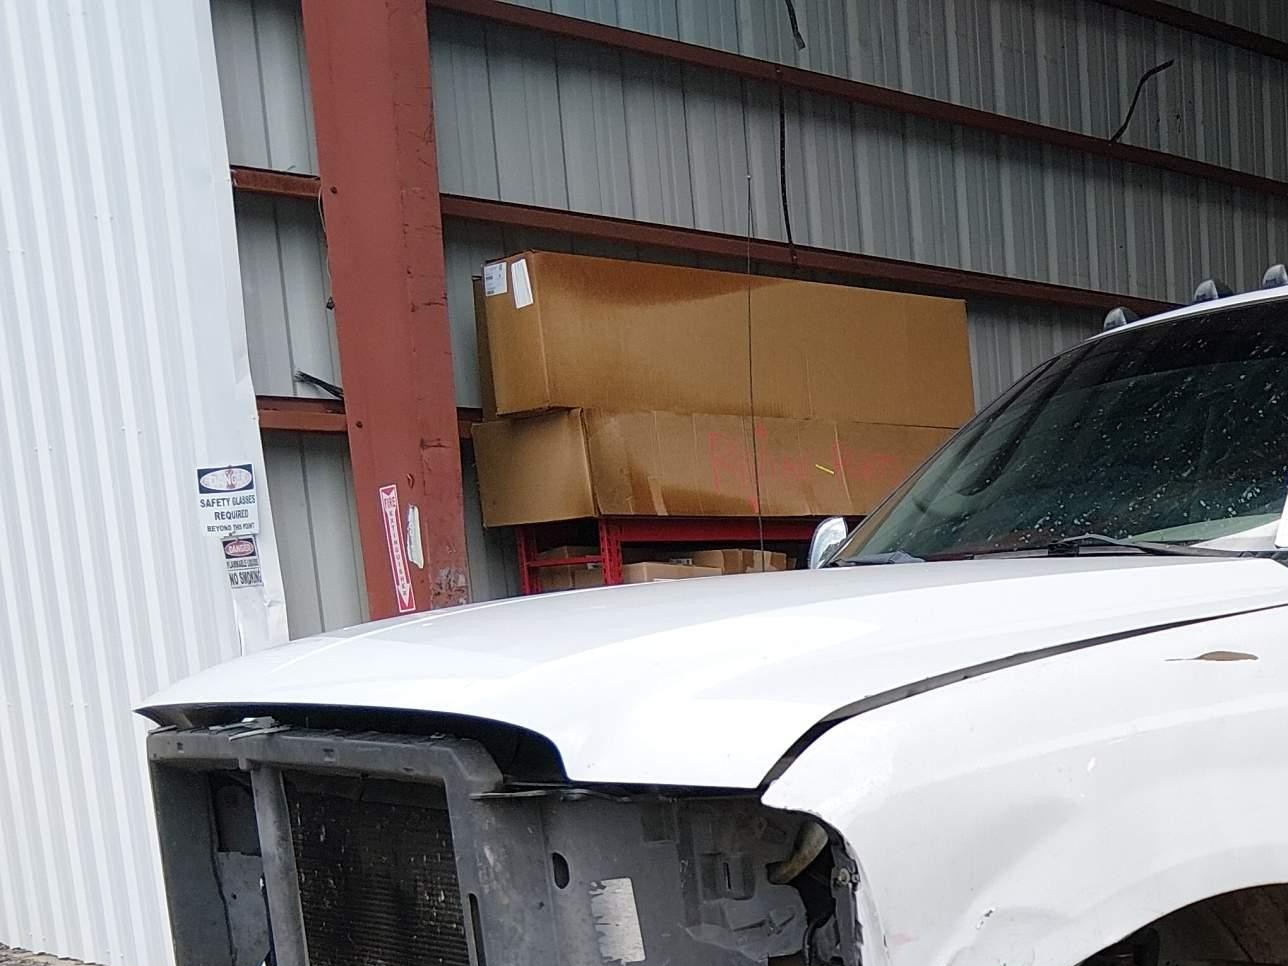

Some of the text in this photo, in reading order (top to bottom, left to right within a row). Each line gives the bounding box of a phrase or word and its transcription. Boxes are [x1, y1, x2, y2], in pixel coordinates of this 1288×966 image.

[200, 498, 231, 508] SAFETY
[214, 509, 249, 520] REQUIRED
[229, 572, 239, 585] NO
